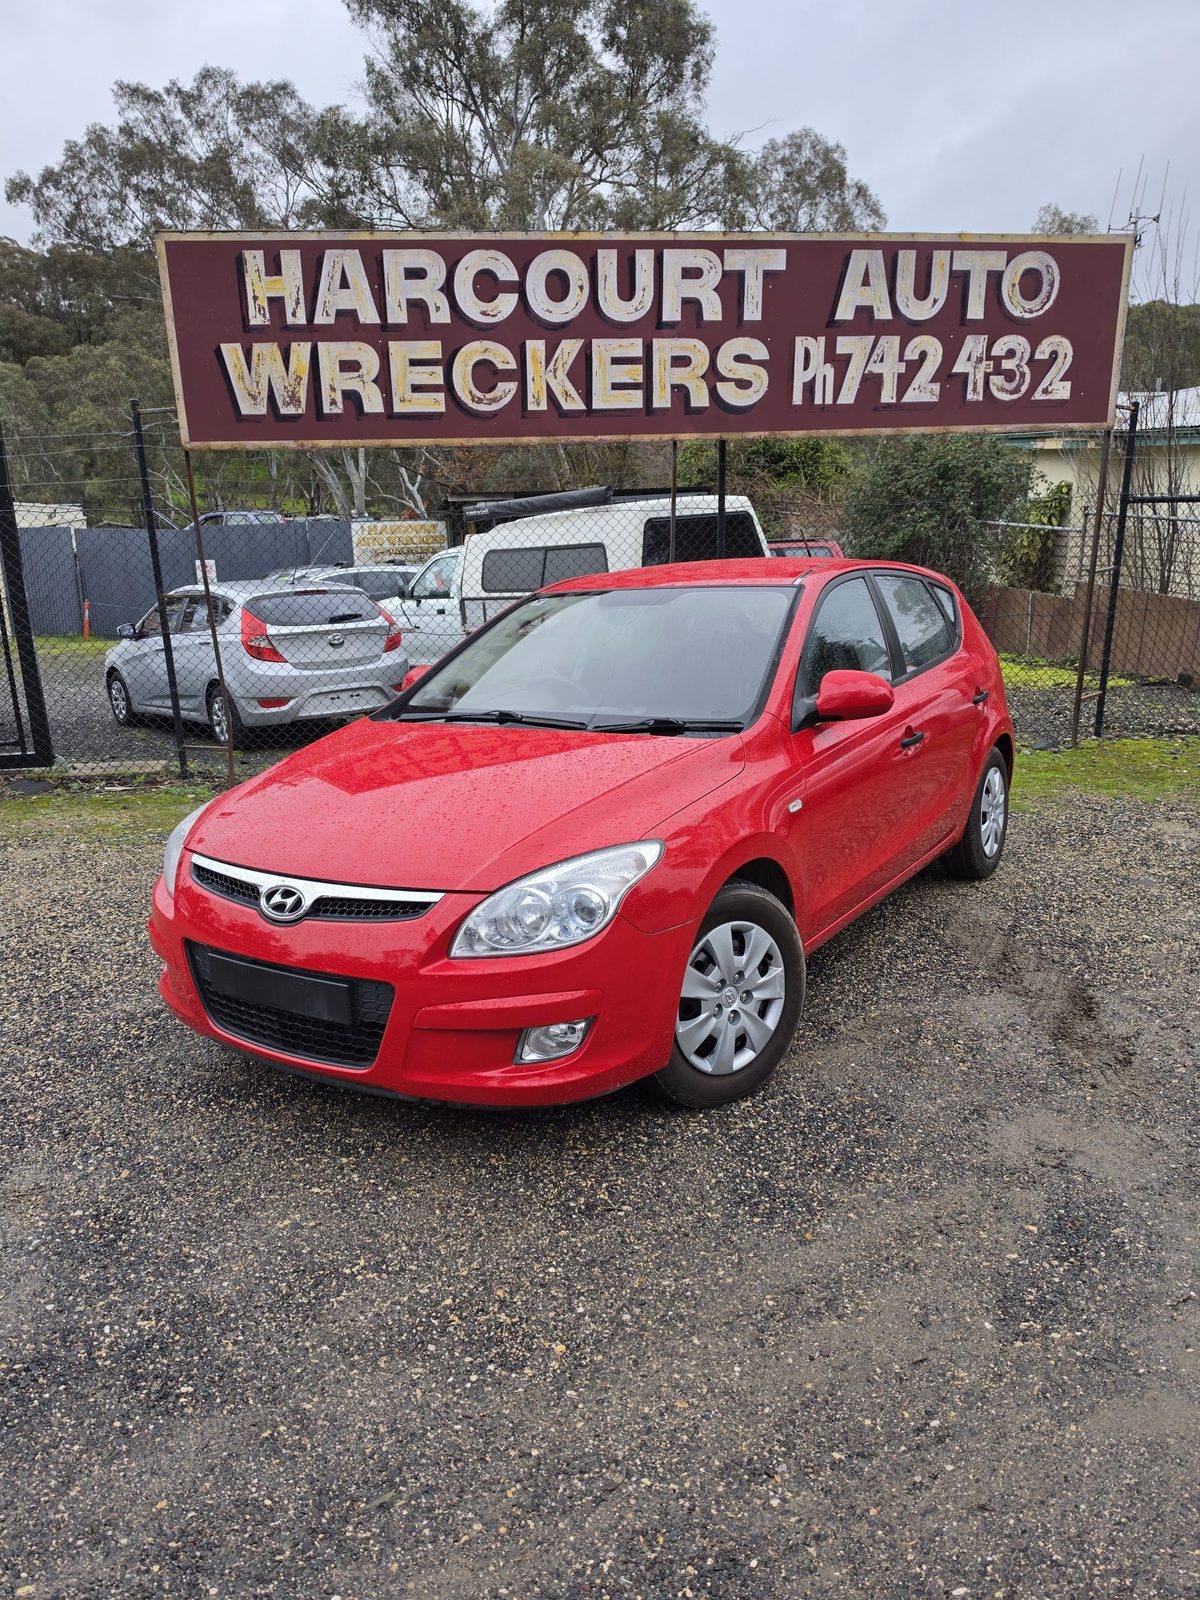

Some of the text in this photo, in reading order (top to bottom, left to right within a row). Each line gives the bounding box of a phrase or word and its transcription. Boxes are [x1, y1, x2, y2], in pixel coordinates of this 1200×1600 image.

[241, 248, 1061, 325] HARCOURT AUTO
[219, 337, 770, 415] WRECKERS
